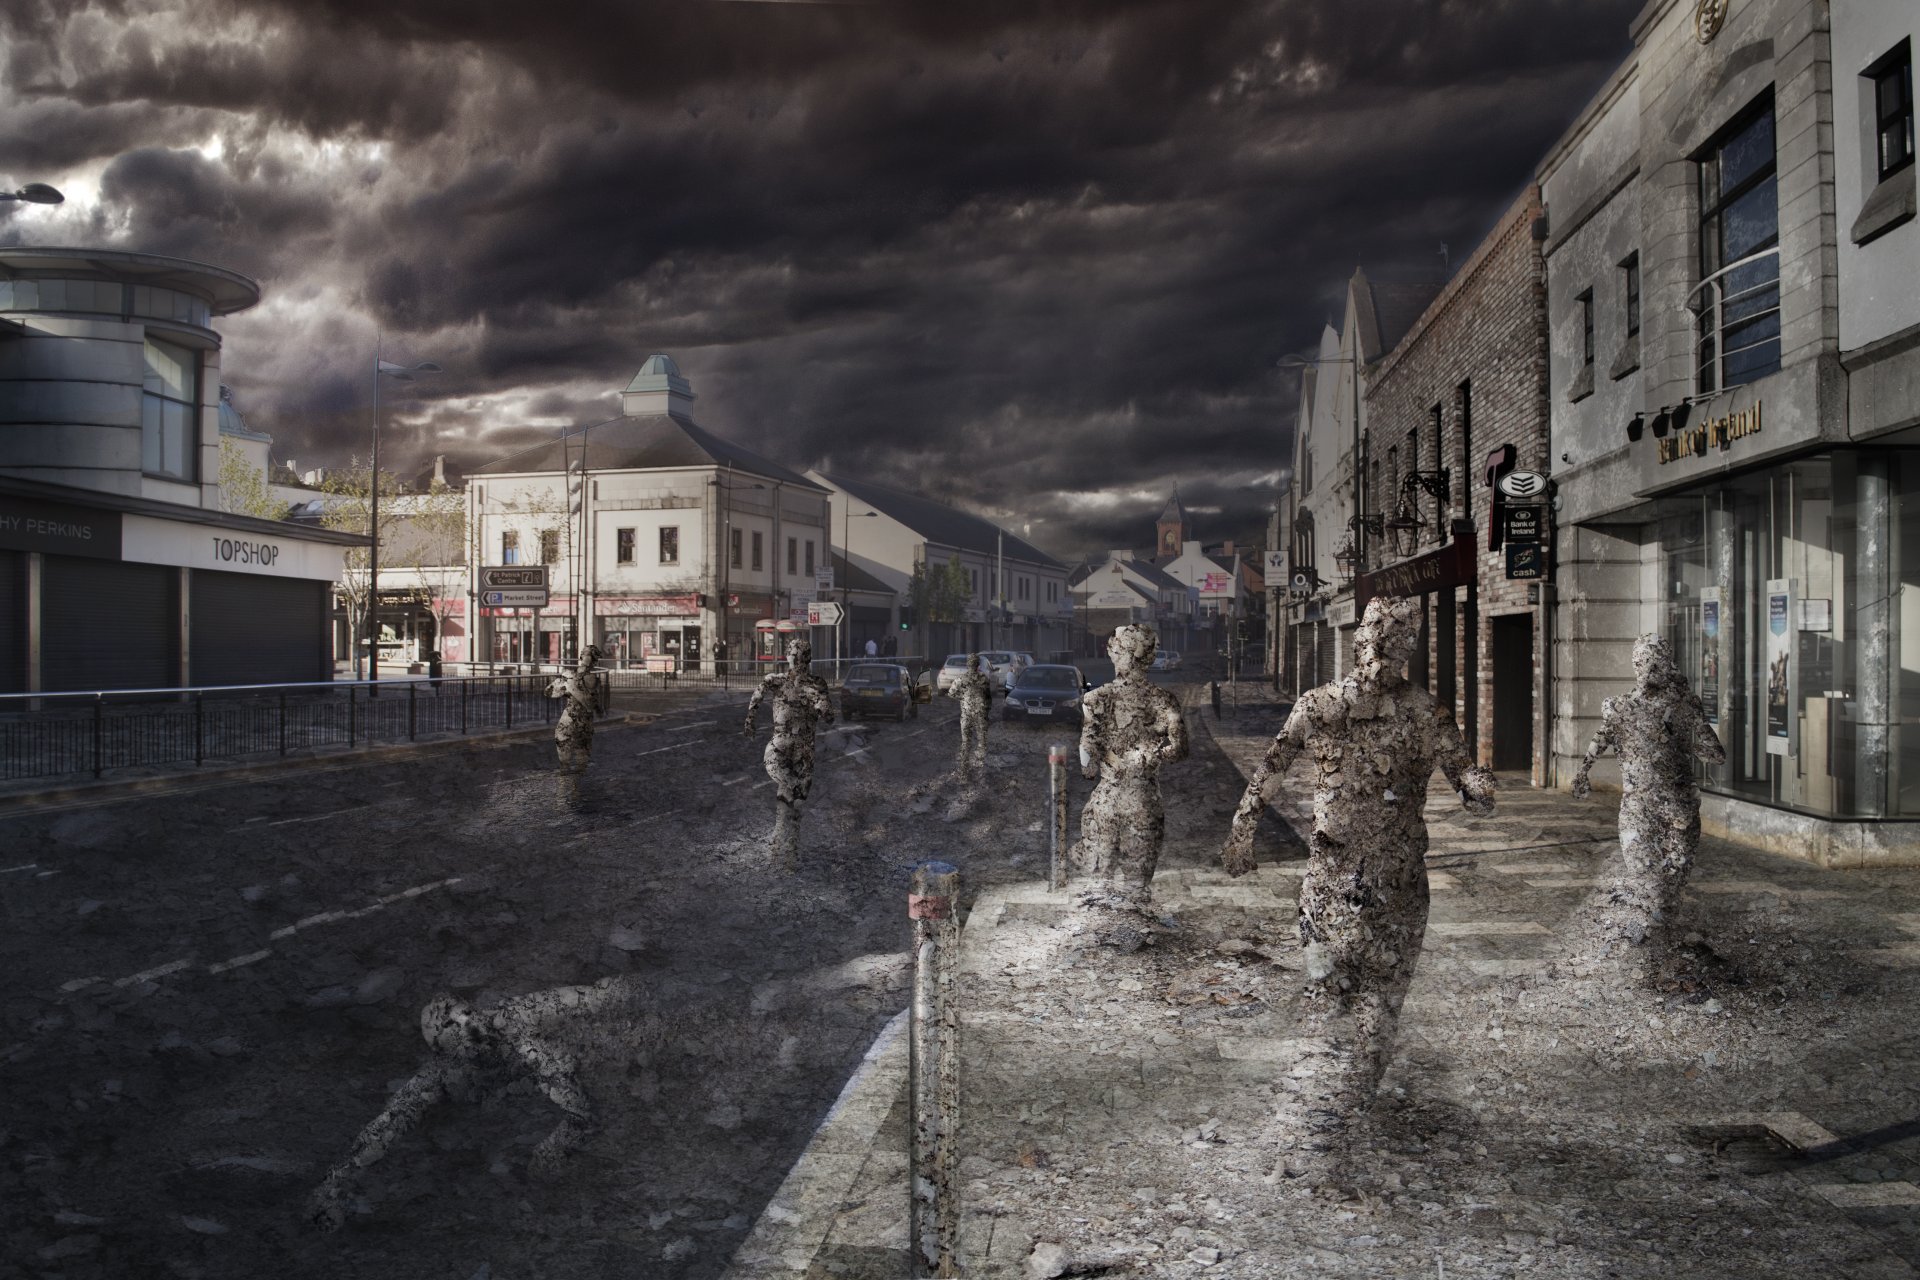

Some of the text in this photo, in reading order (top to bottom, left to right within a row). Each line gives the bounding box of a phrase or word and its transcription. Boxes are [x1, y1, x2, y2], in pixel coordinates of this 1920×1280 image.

[26, 518, 92, 540] PERKINS
[213, 537, 280, 567] TOPSHOP
[1512, 568, 1536, 577] cash
[632, 603, 676, 613] Santander
